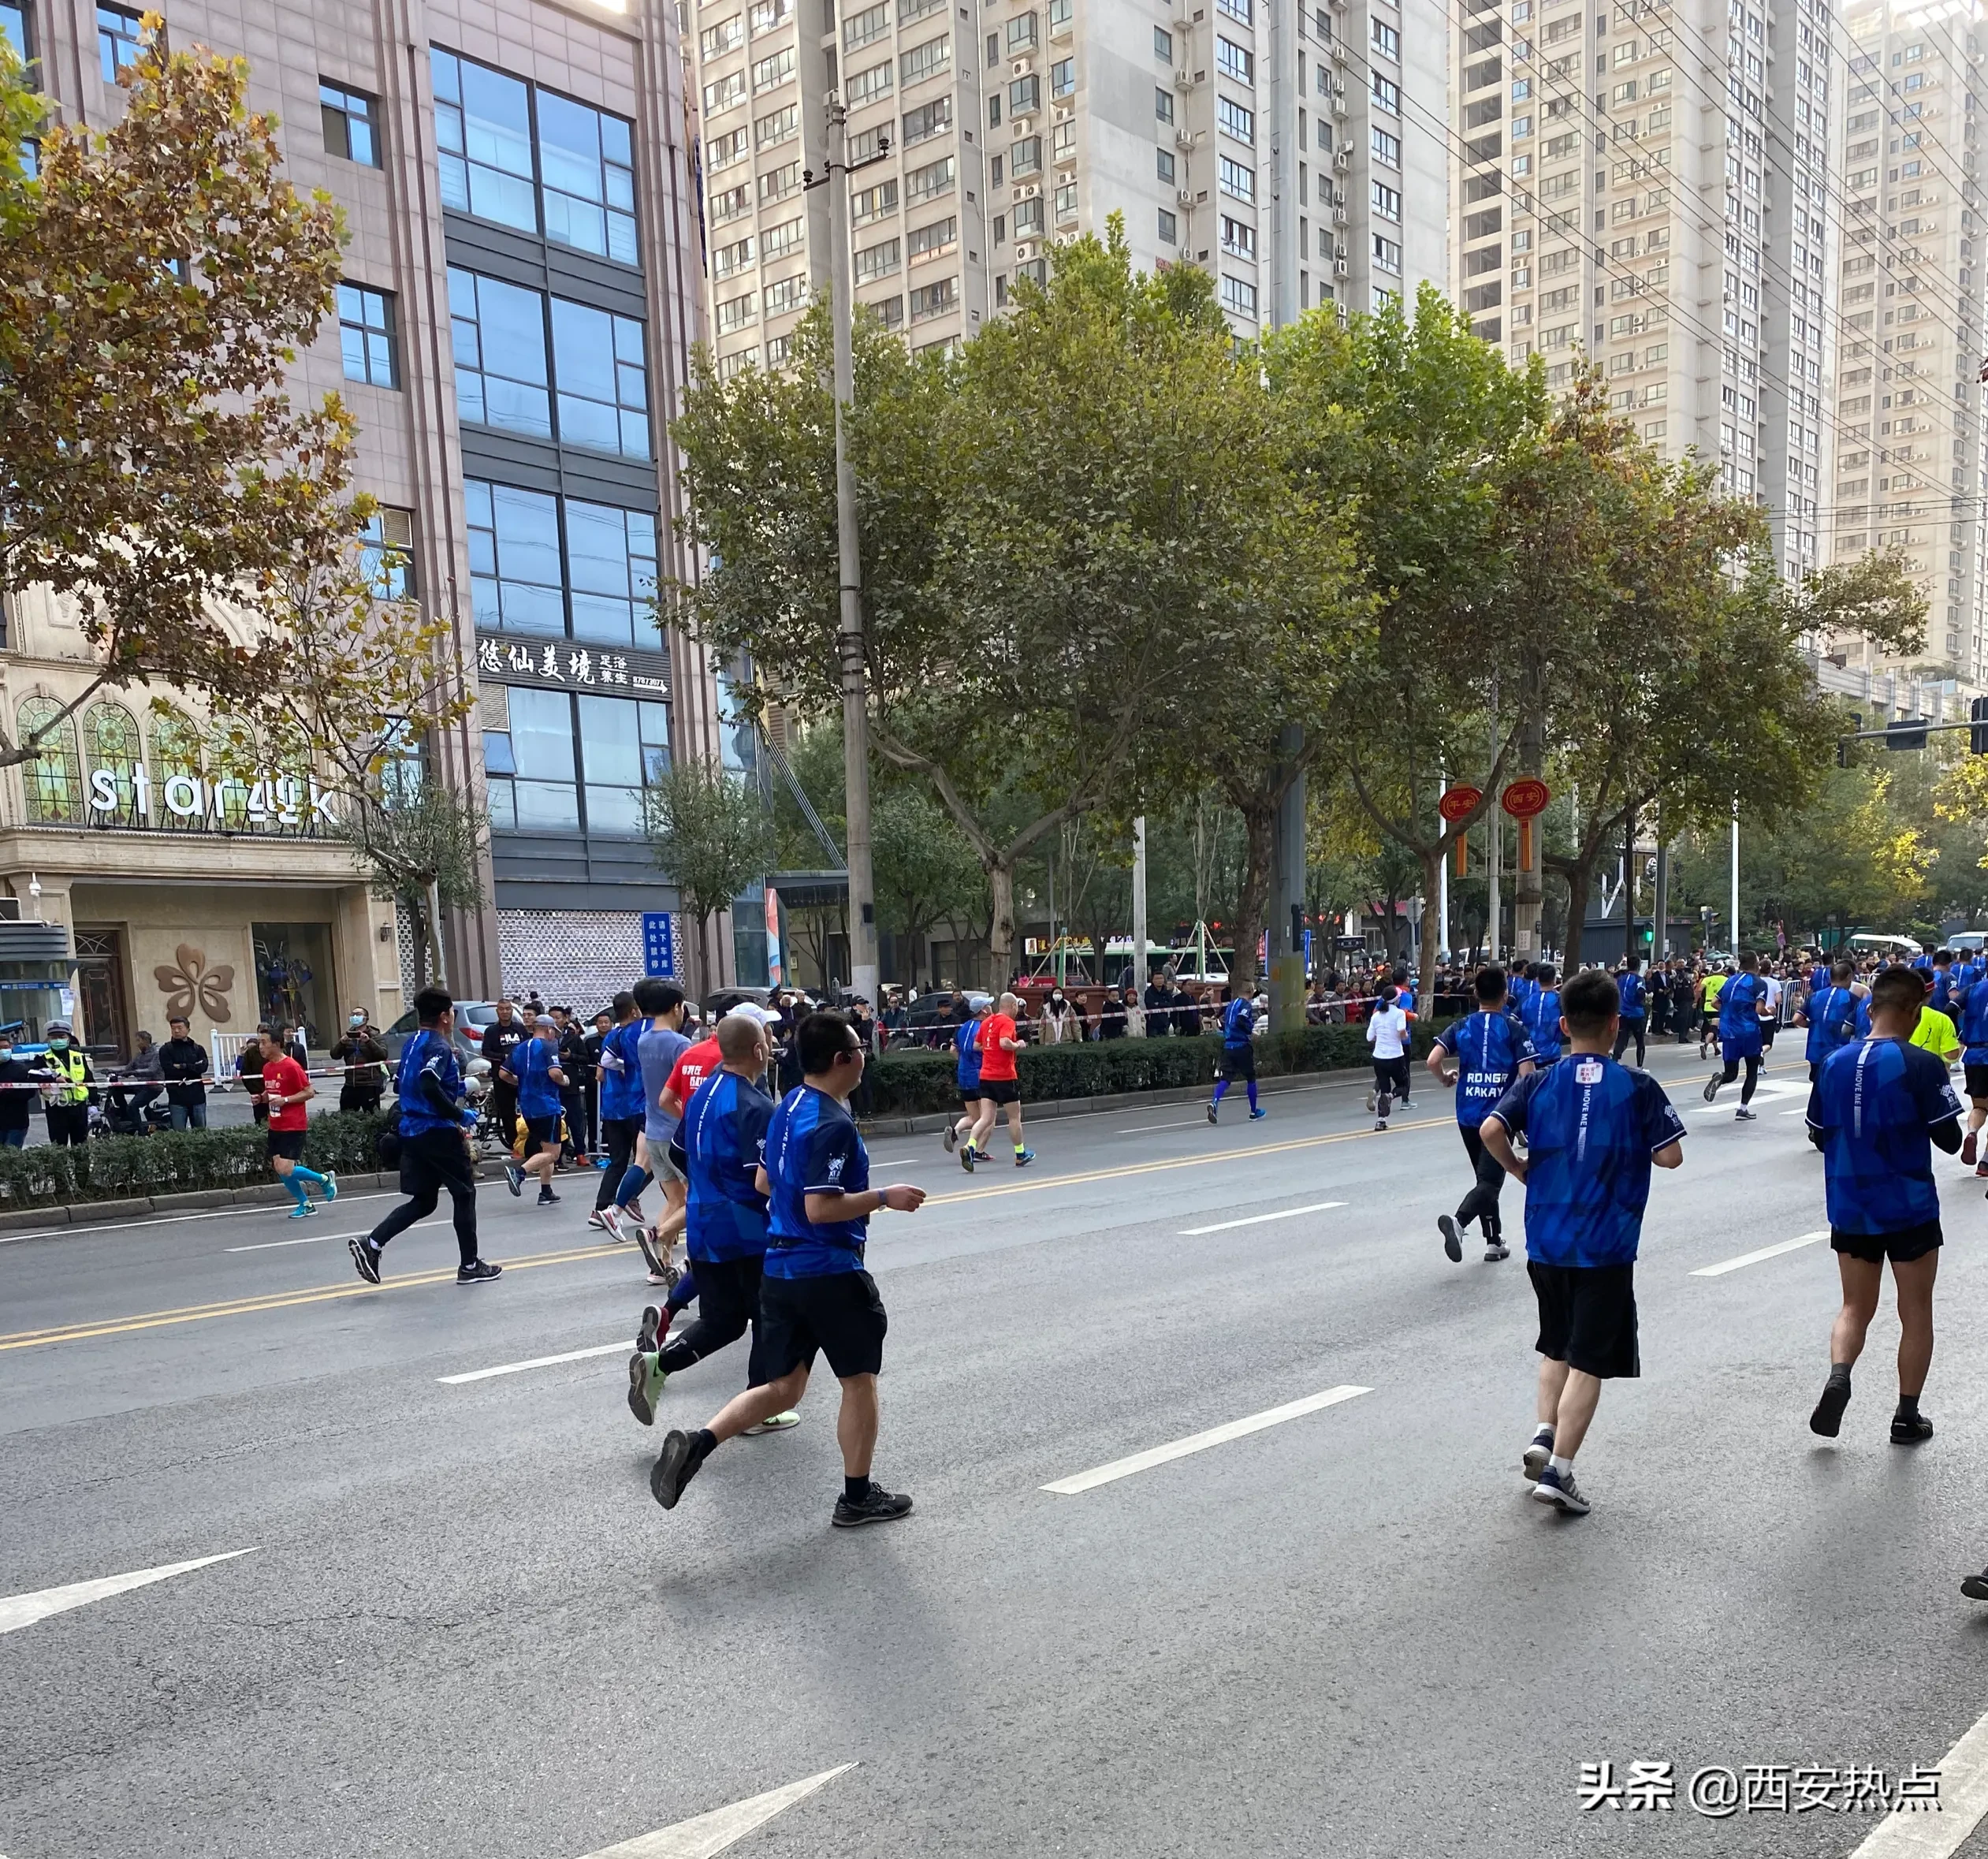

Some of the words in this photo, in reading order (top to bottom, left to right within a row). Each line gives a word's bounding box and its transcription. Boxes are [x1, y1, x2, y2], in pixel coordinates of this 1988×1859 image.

[478, 639, 595, 684] 悠仙美境
[599, 654, 627, 669] 足浴
[600, 670, 628, 684] 养生
[1449, 799, 1475, 810] 平安
[1511, 792, 1538, 804] 西安
[499, 1033, 520, 1043] FILA
[1854, 1069, 1863, 1092] MOVE
[1582, 1090, 1591, 1113] MOVE
[1854, 1093, 1862, 1105] ME
[1580, 1113, 1588, 1127] ME
